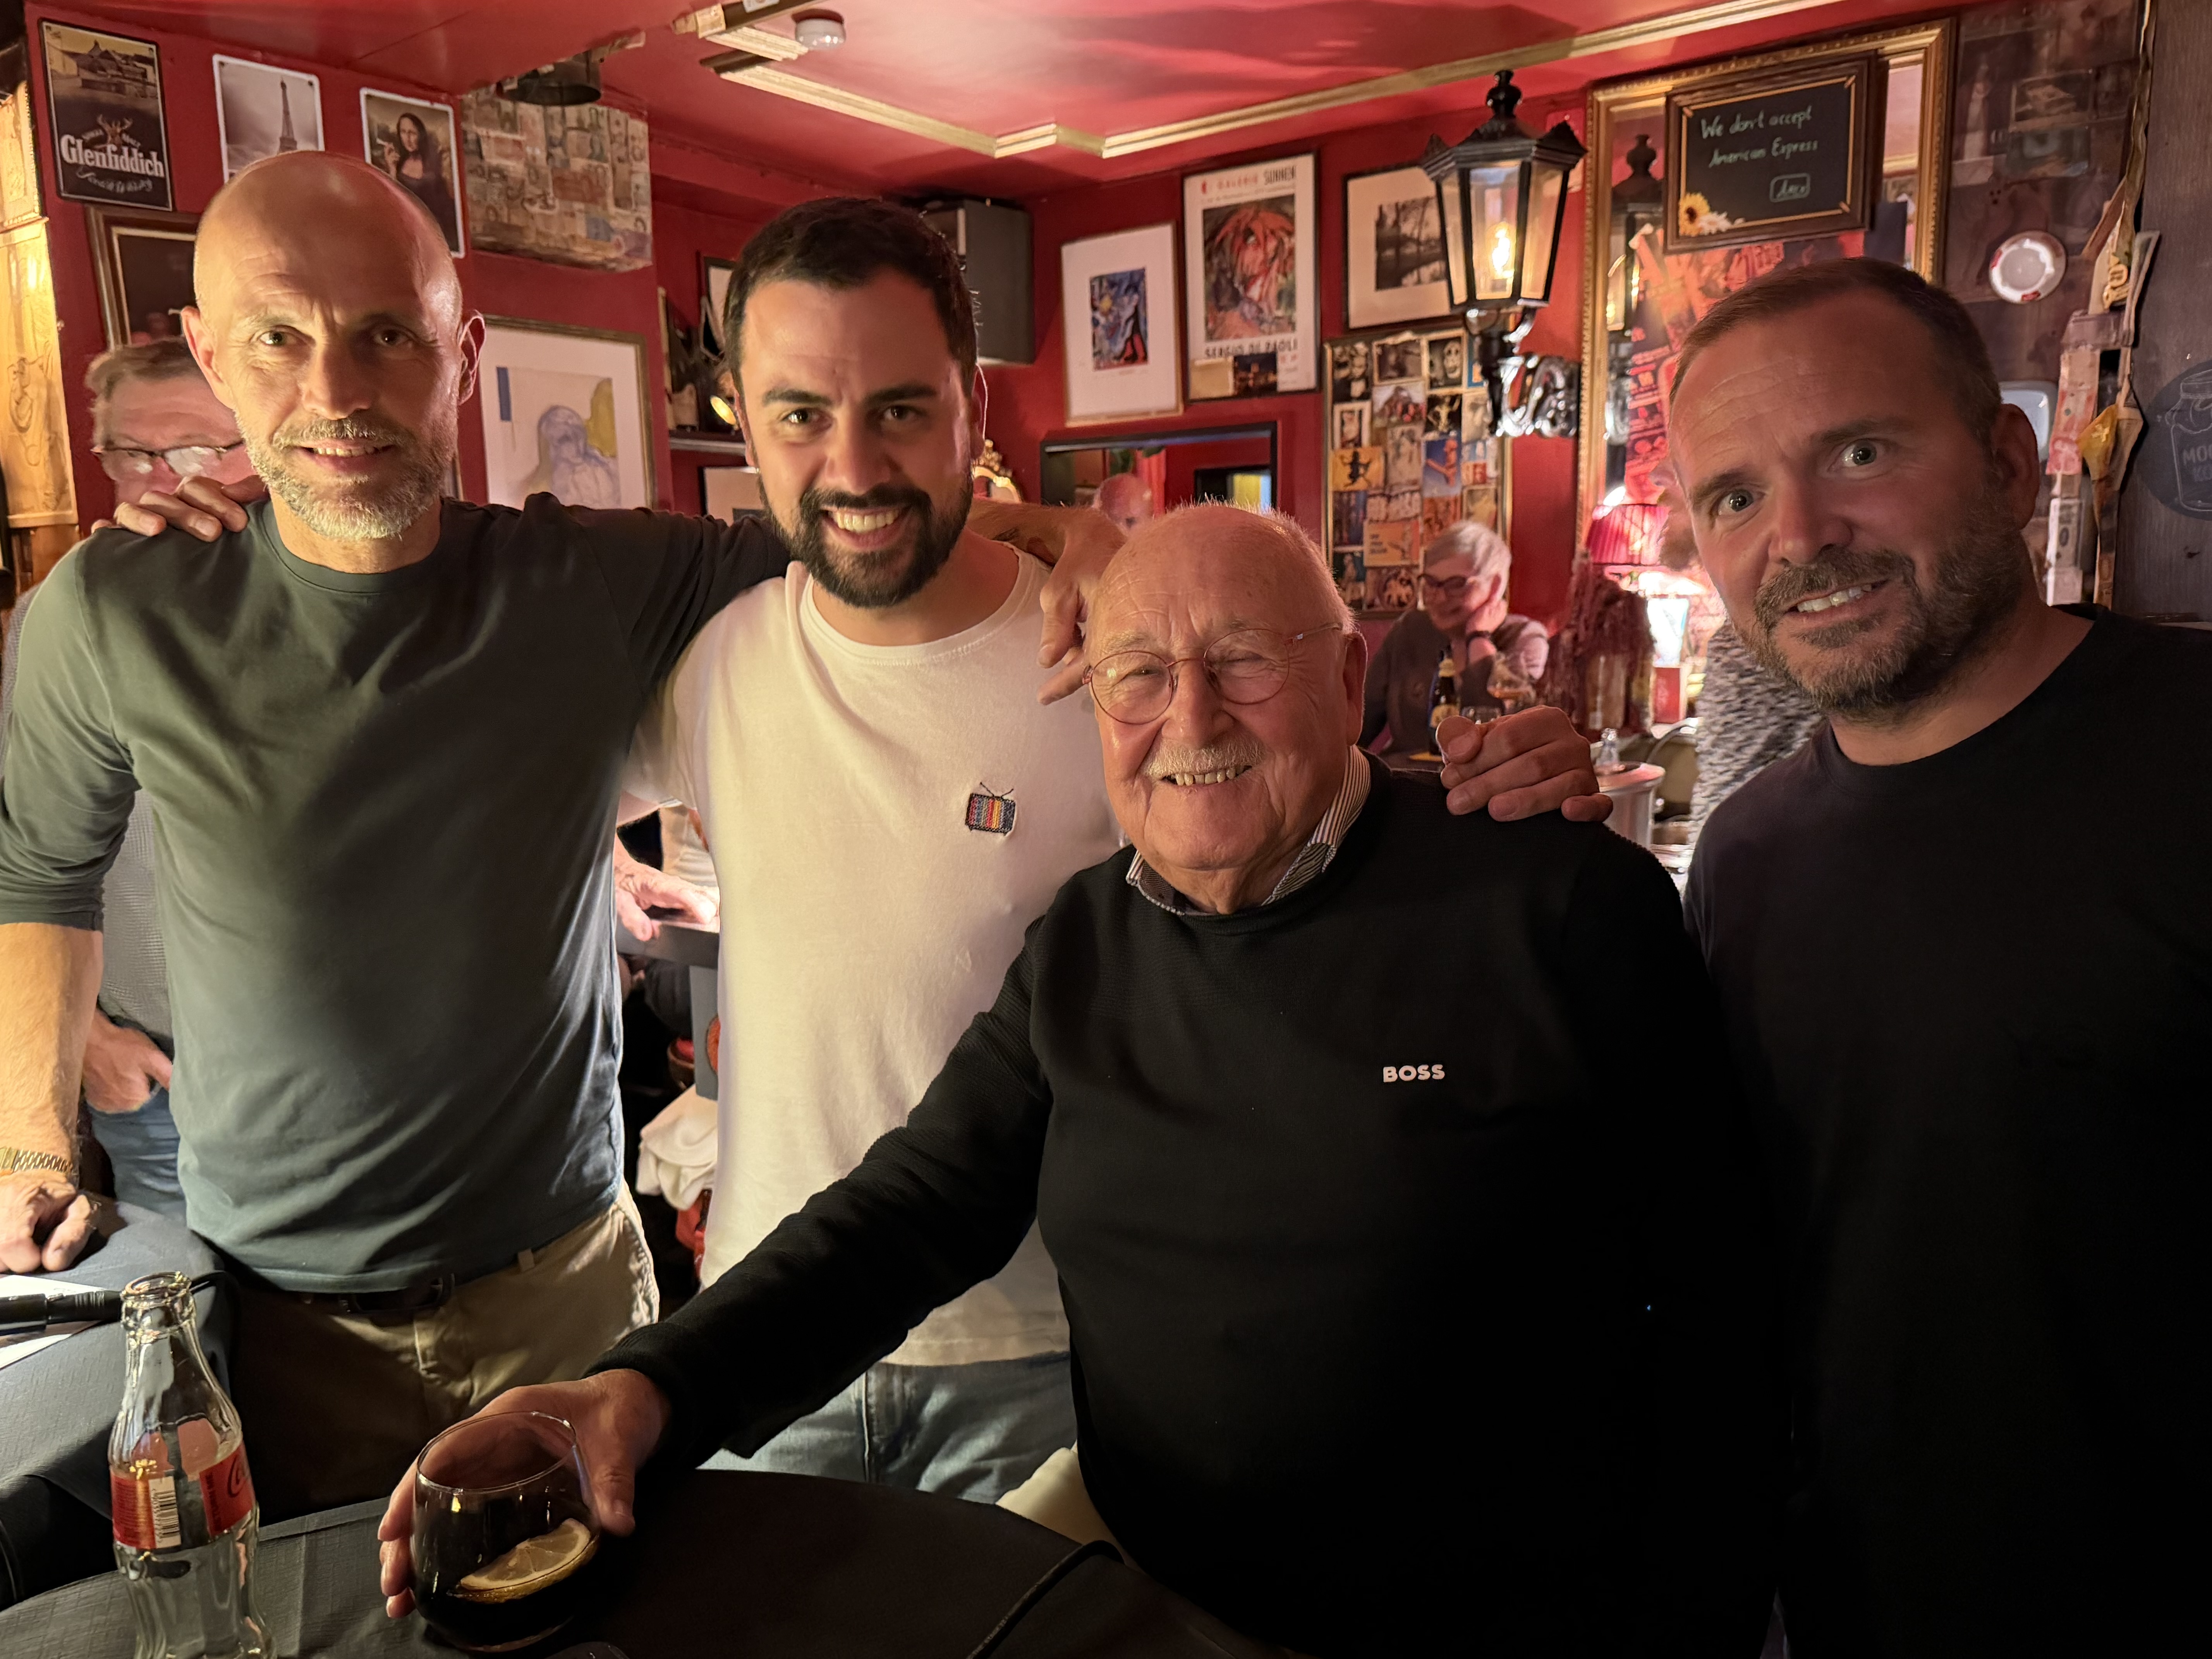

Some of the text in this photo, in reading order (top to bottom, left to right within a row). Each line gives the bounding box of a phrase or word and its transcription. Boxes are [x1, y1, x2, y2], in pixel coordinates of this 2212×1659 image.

[1701, 115, 1723, 139] We
[1769, 105, 1812, 129] accept
[60, 134, 165, 178] Glenfiddich
[1771, 137, 1819, 160] Express
[1383, 1064, 1445, 1083] BOSS
